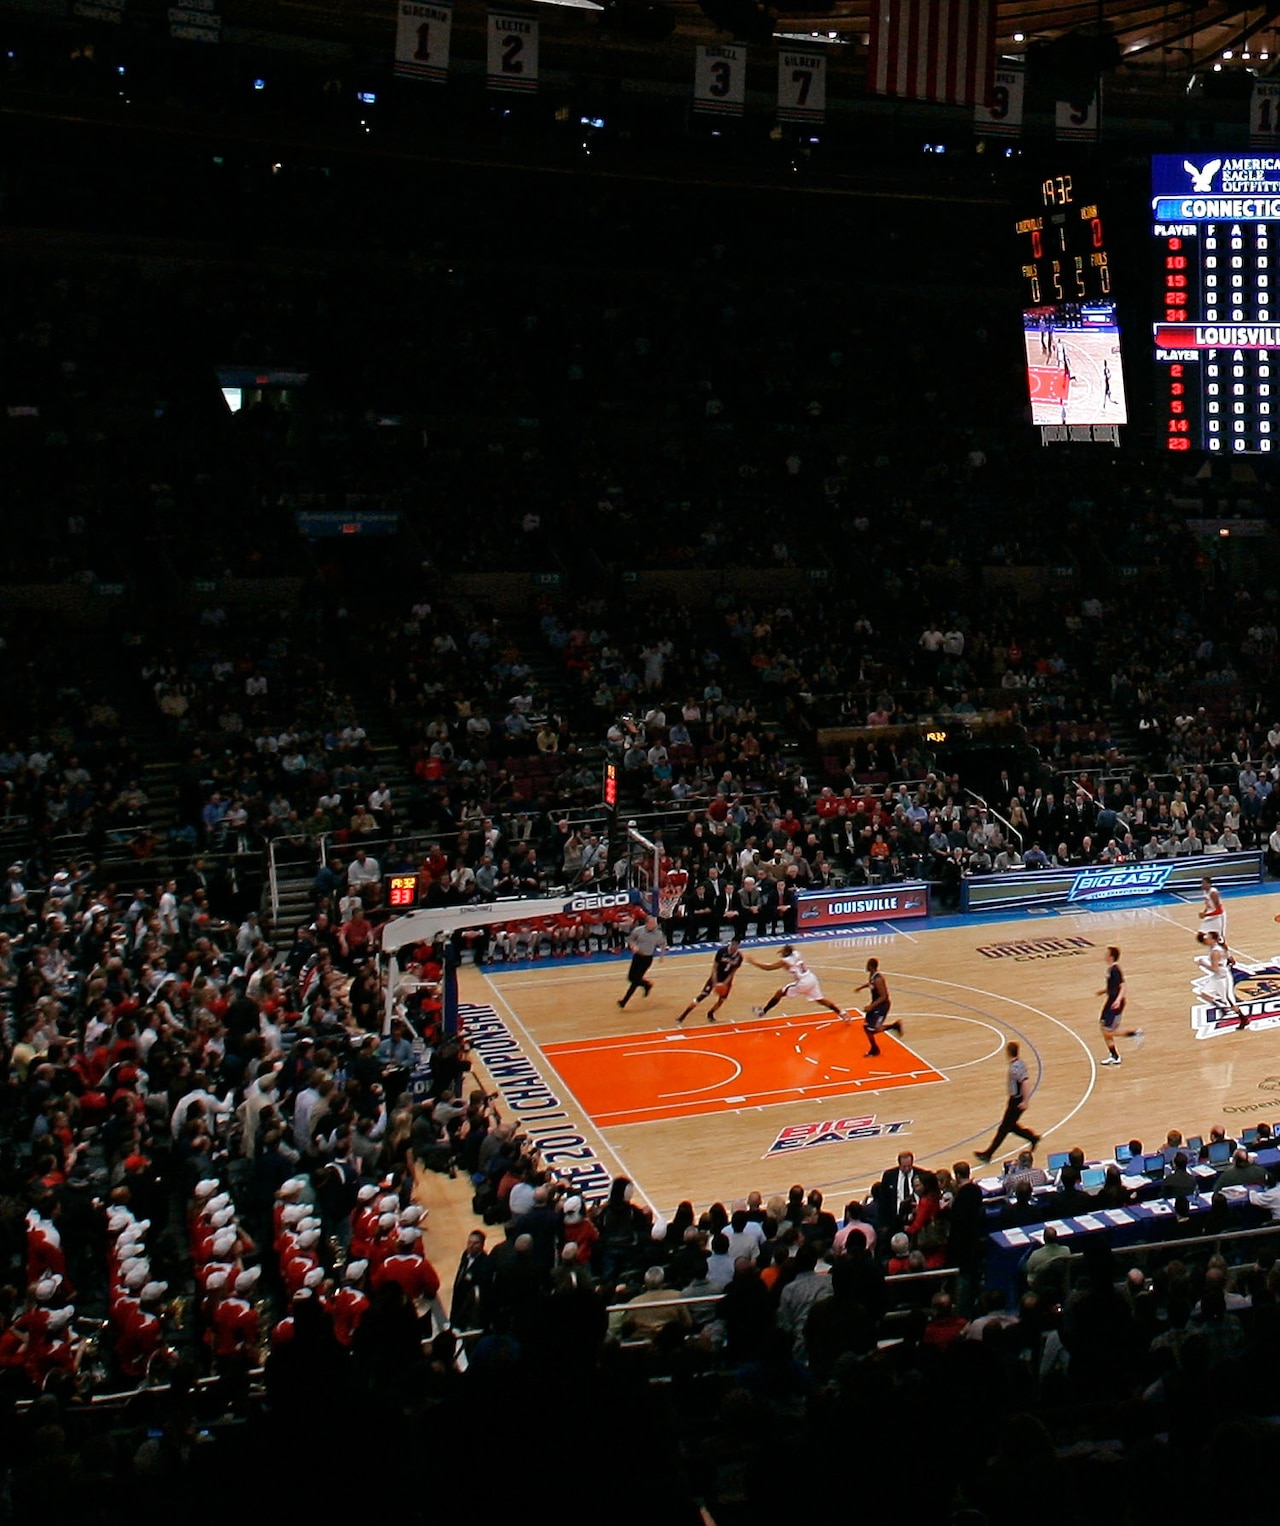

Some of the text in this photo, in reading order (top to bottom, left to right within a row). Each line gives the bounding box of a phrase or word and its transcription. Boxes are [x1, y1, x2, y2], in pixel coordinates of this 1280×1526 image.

[414, 22, 430, 61] 1
[502, 35, 523, 74] 2
[709, 61, 731, 98] 3
[791, 70, 813, 106] 7
[1222, 170, 1265, 182] EAGLE
[1153, 225, 1197, 236] PLAYER
[1207, 225, 1216, 236] F
[1231, 225, 1242, 236] A
[1258, 224, 1268, 236] R
[1206, 238, 1216, 249] 0
[1232, 238, 1242, 249] 0
[1258, 238, 1268, 249] 0
[1166, 256, 1187, 269] 10
[1206, 257, 1216, 268] 0
[1232, 257, 1242, 268] 0
[1258, 257, 1268, 268] 0
[1053, 273, 1063, 300] 5
[1075, 270, 1085, 298] 5
[1206, 275, 1216, 287] 0
[1232, 275, 1242, 287] 0
[1258, 275, 1268, 287] 0
[1032, 277, 1041, 303] 0
[1165, 292, 1187, 305] 22
[1206, 292, 1216, 304] 0
[1232, 292, 1242, 304] 0
[1258, 292, 1268, 304] 0
[1206, 310, 1216, 321] 0
[1232, 310, 1242, 321] 0
[1258, 310, 1268, 321] 0
[1156, 350, 1199, 361] PLAYER
[1209, 350, 1217, 361] F
[1233, 350, 1244, 361] A
[1259, 350, 1269, 361] R
[1208, 365, 1218, 376] 0
[1234, 365, 1243, 376] 0
[1259, 365, 1269, 376] 0
[1208, 384, 1218, 395] 0
[1234, 384, 1244, 395] 0
[1260, 384, 1269, 395] 0
[1209, 402, 1219, 414] 0
[1234, 402, 1244, 414] 0
[1260, 402, 1269, 414] 0
[1169, 420, 1188, 432] 14
[1209, 420, 1219, 433] 0
[1234, 420, 1244, 433] 0
[1260, 420, 1270, 433] 0
[1168, 438, 1190, 450] 23
[1210, 439, 1220, 451] 0
[1235, 439, 1245, 451] 0
[1260, 439, 1270, 451] 0
[391, 877, 416, 889] 19:32
[391, 889, 413, 905] 33
[571, 894, 630, 911] GEICO
[828, 897, 899, 915] LOUISVILLE
[976, 936, 1097, 959] GARDEN
[1013, 949, 1088, 963] CHASE
[456, 1003, 561, 1112] CHAMPIONSHIP
[777, 1114, 877, 1139] BIG
[518, 1111, 598, 1164] 2011
[768, 1120, 914, 1152] EAST
